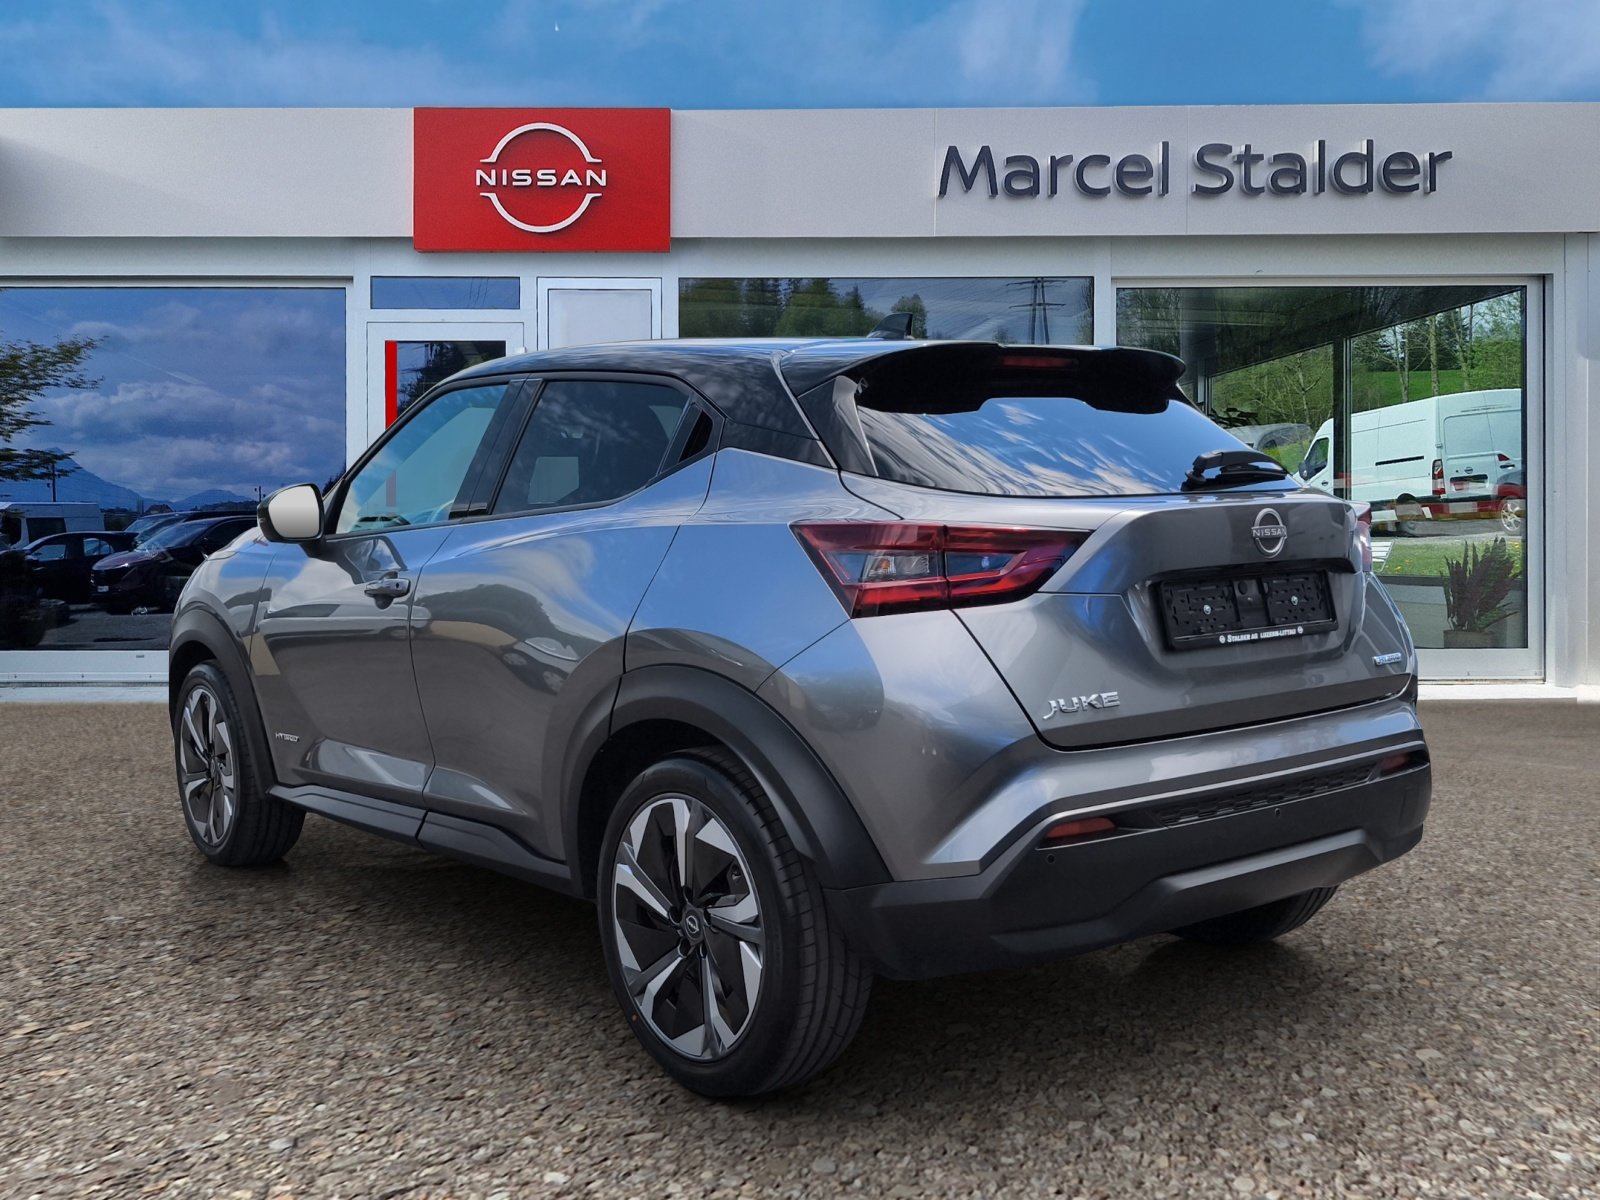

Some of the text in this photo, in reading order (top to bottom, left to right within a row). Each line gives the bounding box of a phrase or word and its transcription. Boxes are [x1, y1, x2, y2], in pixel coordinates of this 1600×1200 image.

[938, 138, 1453, 197] Marcel Stalder
[475, 169, 607, 186] NISSAN
[1252, 528, 1287, 537] NISSAN
[1260, 628, 1296, 638] LU-LITT
[1042, 691, 1120, 719] JUKE
